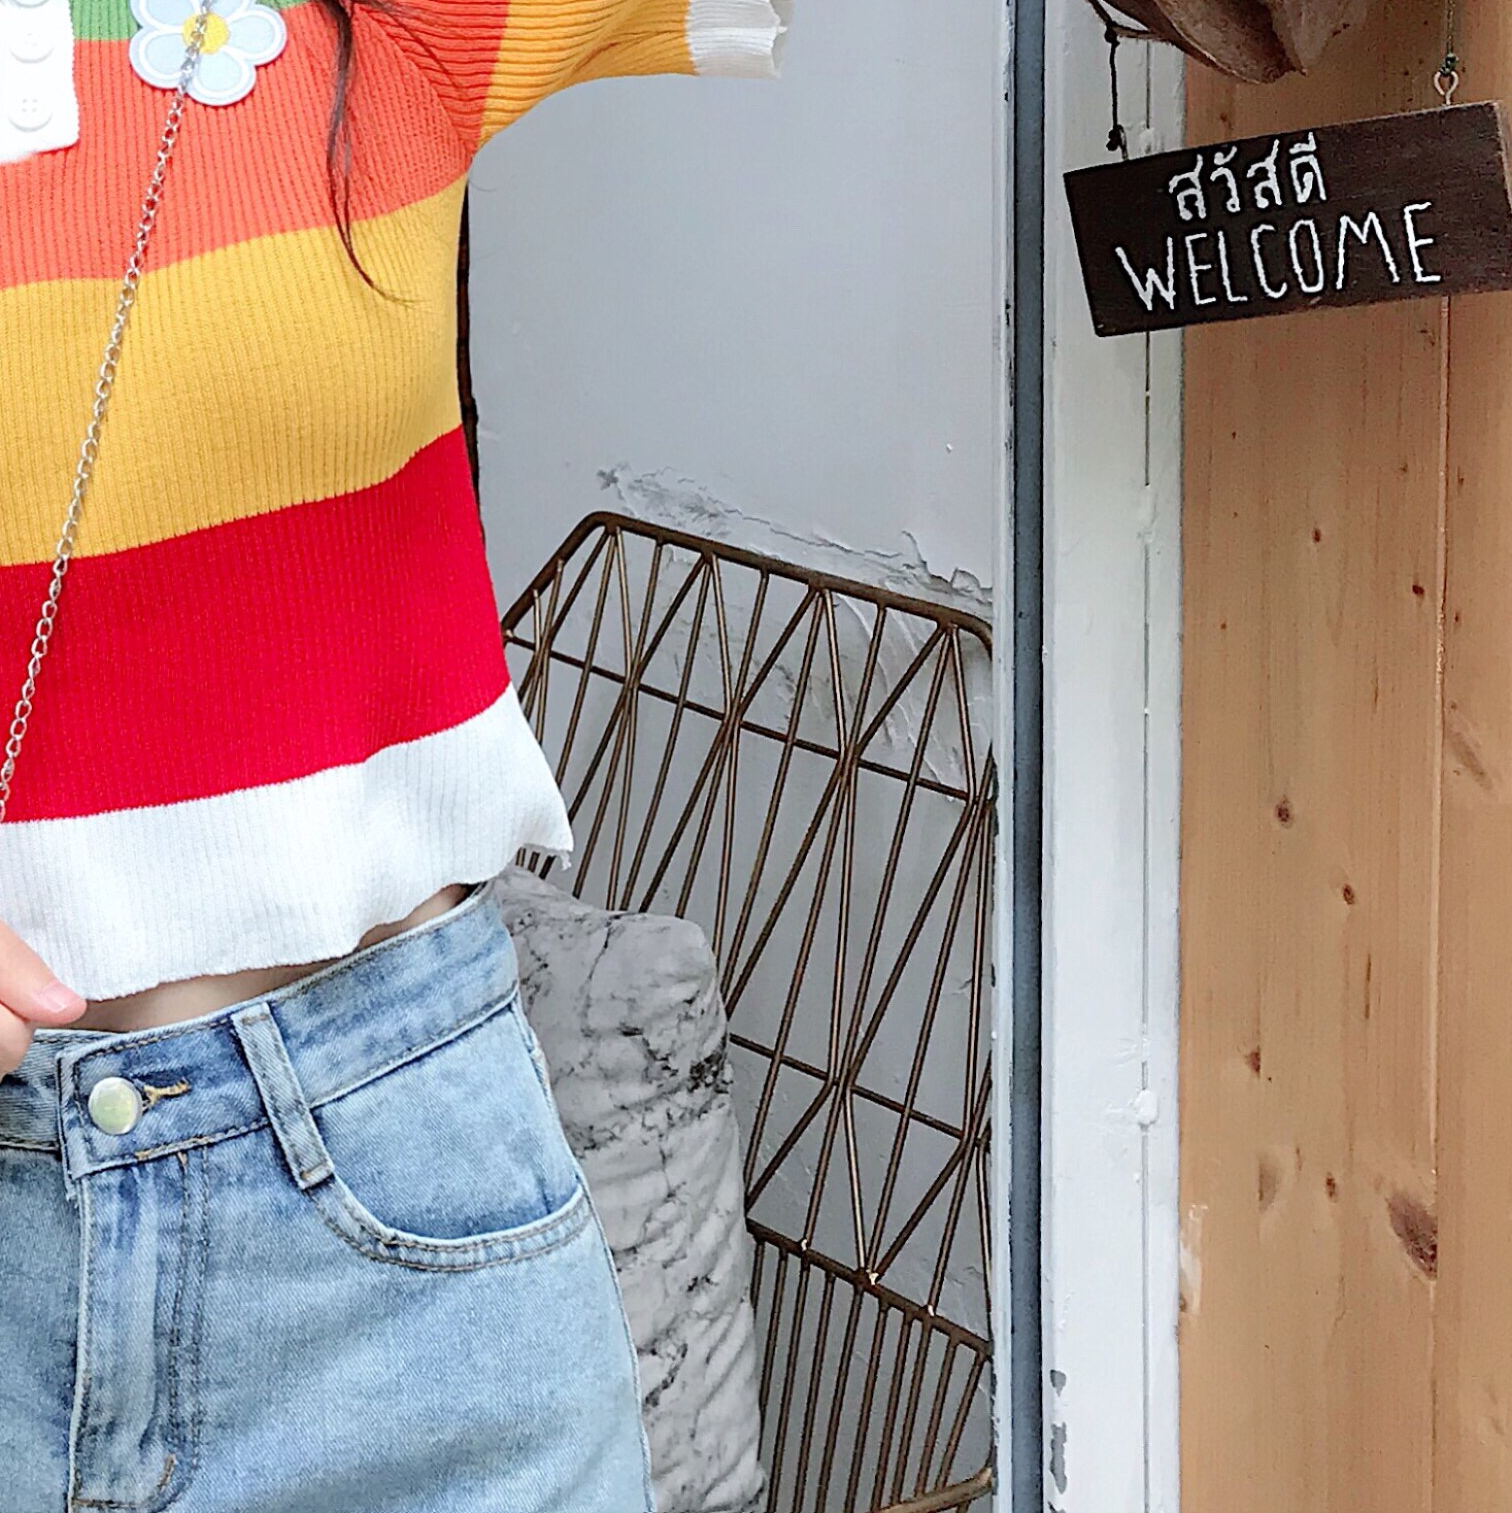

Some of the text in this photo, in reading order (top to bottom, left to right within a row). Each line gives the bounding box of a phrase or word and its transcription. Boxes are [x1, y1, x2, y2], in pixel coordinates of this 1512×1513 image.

[1169, 131, 1327, 220] สวัสดี
[1115, 201, 1441, 311] WELCOME
